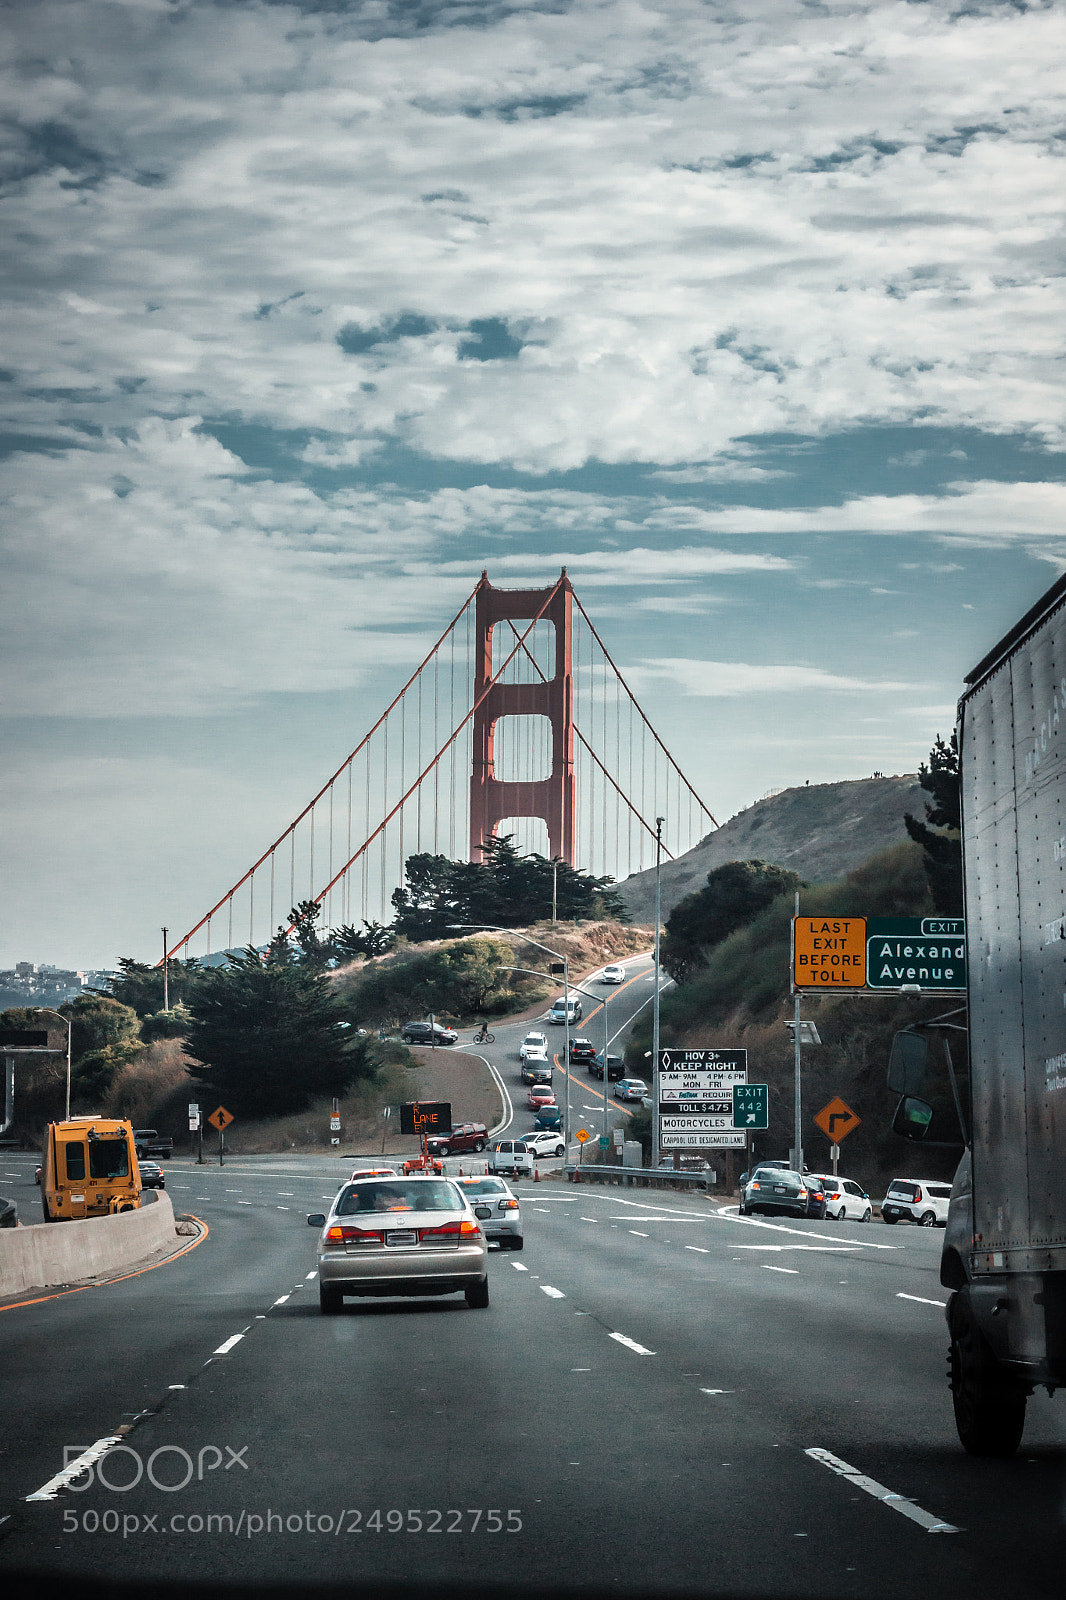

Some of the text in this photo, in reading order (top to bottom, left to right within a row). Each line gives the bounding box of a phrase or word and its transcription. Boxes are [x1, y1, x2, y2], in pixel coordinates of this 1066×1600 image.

[810, 922, 851, 933] LAST
[929, 923, 958, 932] EXIT
[813, 939, 847, 949] EXIT
[800, 955, 862, 966] BEFORE
[880, 964, 954, 979] Avenue
[811, 971, 850, 982] TOLL
[685, 1052, 720, 1060] HOV 3+
[673, 1062, 738, 1071] KEEP RIGHT
[737, 1088, 763, 1097] EXIT
[679, 1104, 700, 1112] TOLL
[739, 1102, 762, 1111] 442
[413, 1113, 439, 1124] LANE
[664, 1119, 726, 1127] MOTORCYCLES
[687, 1136, 697, 1144] USE
[730, 1136, 744, 1144] LANE
